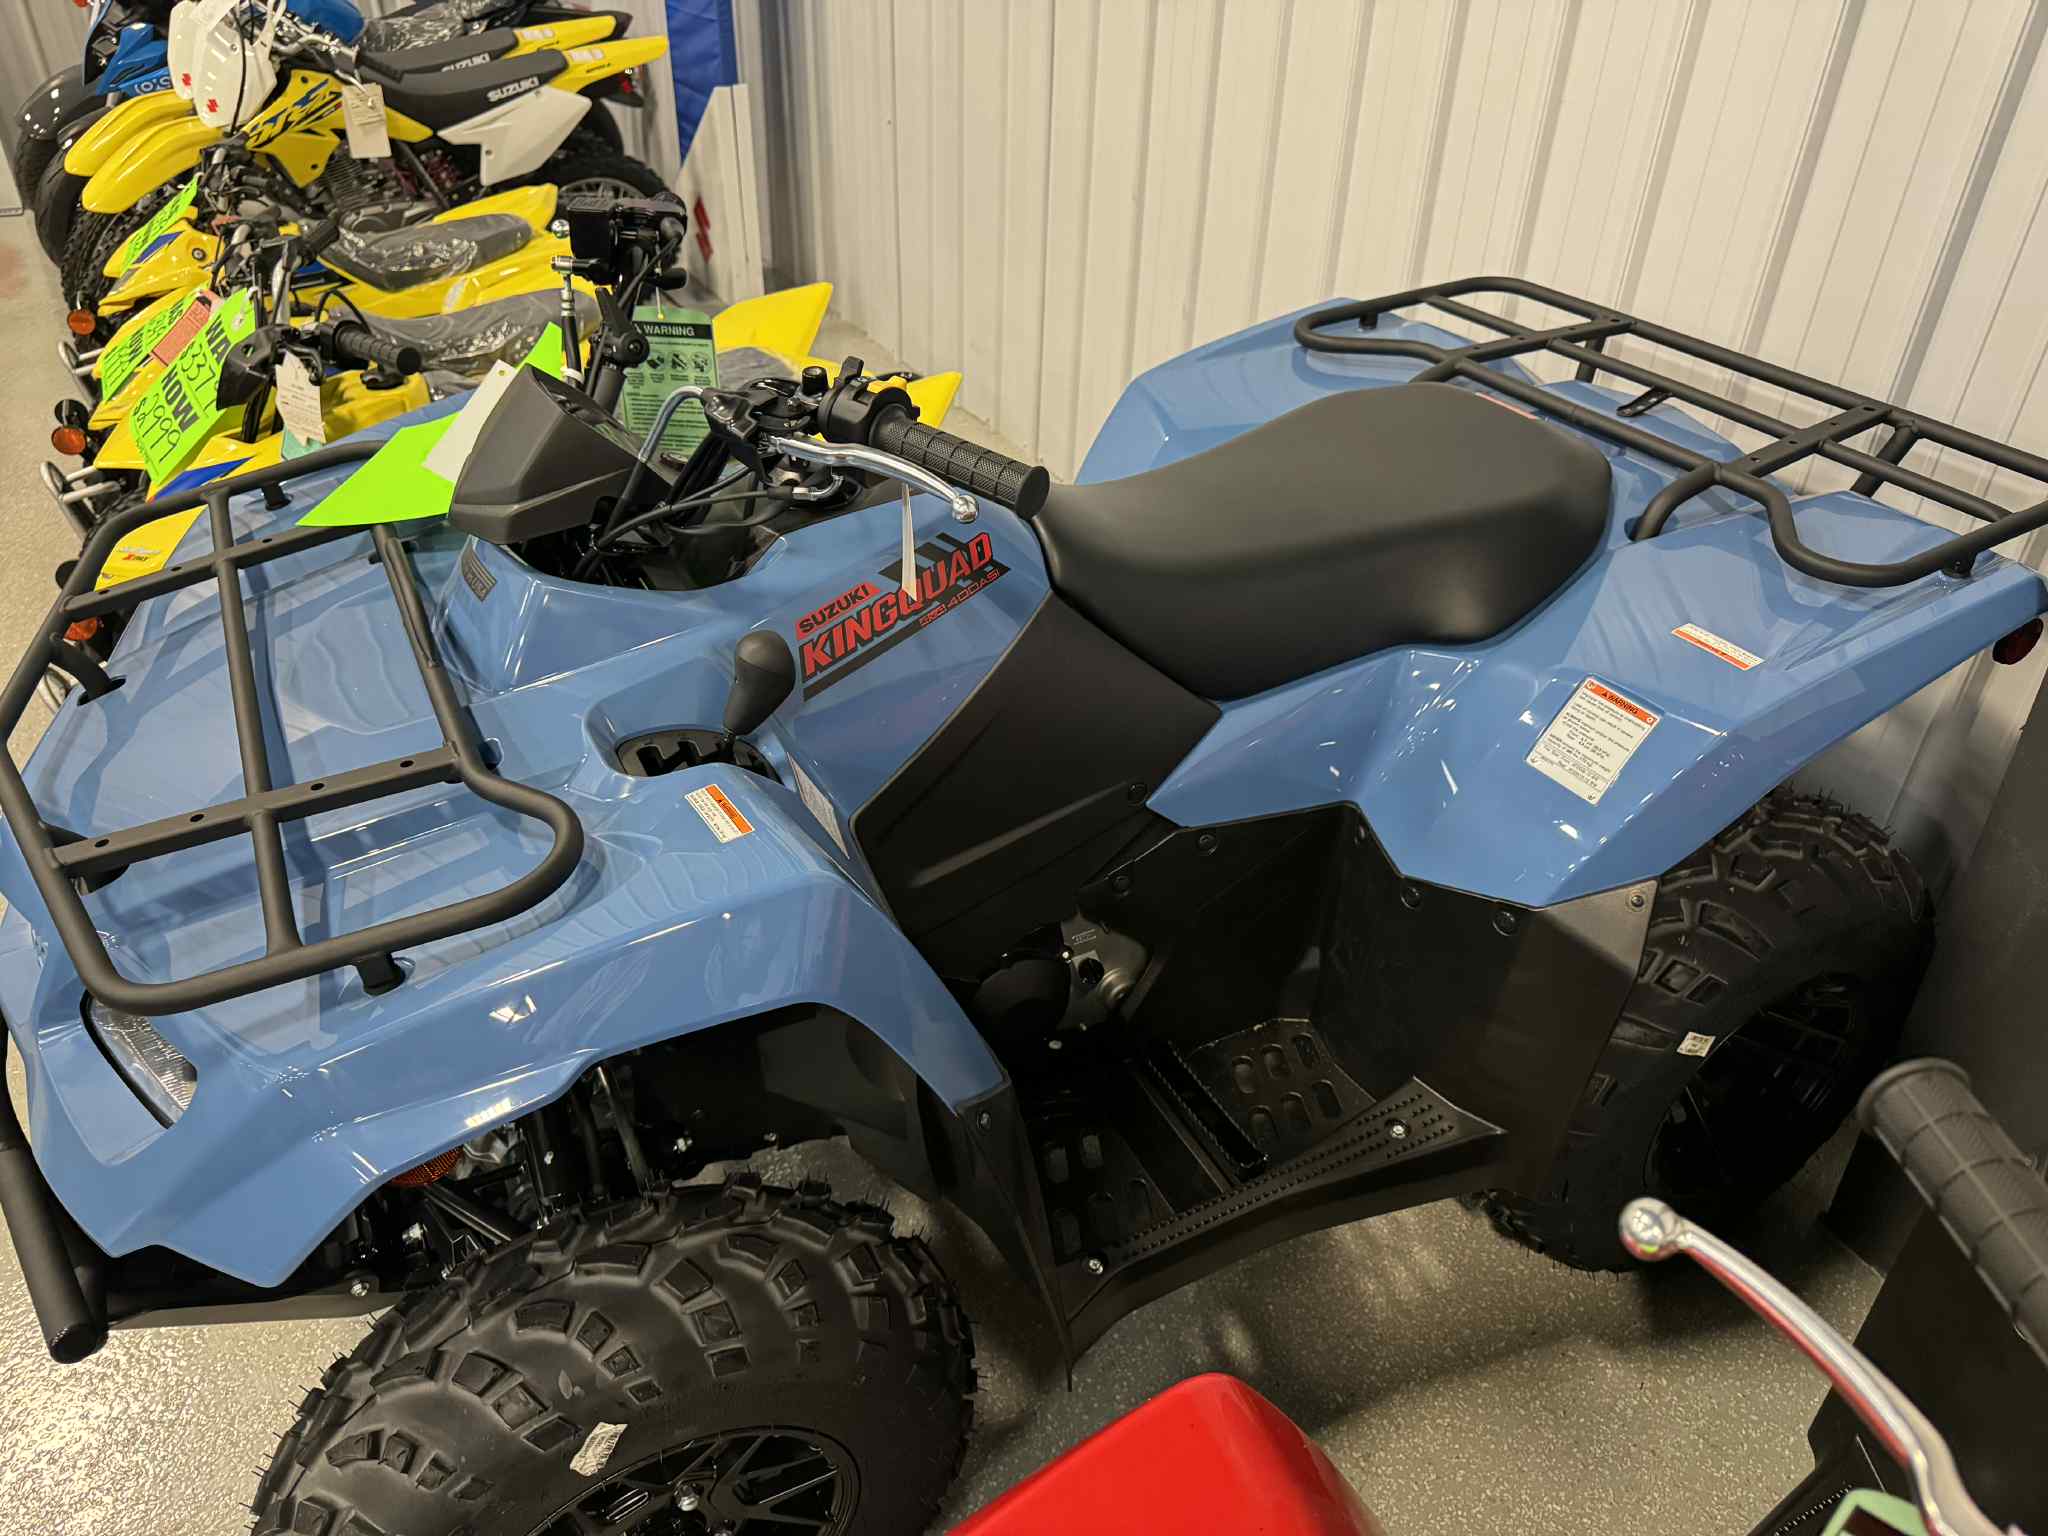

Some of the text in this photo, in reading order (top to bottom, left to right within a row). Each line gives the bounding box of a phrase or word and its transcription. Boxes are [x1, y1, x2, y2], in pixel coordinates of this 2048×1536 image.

[486, 76, 539, 102] SUZUKI
[205, 313, 232, 364] WA
[644, 324, 696, 337] WARNING
[161, 364, 200, 433] NOW
[799, 582, 872, 634] SUZUKI
[800, 531, 993, 681] KINGQUAD
